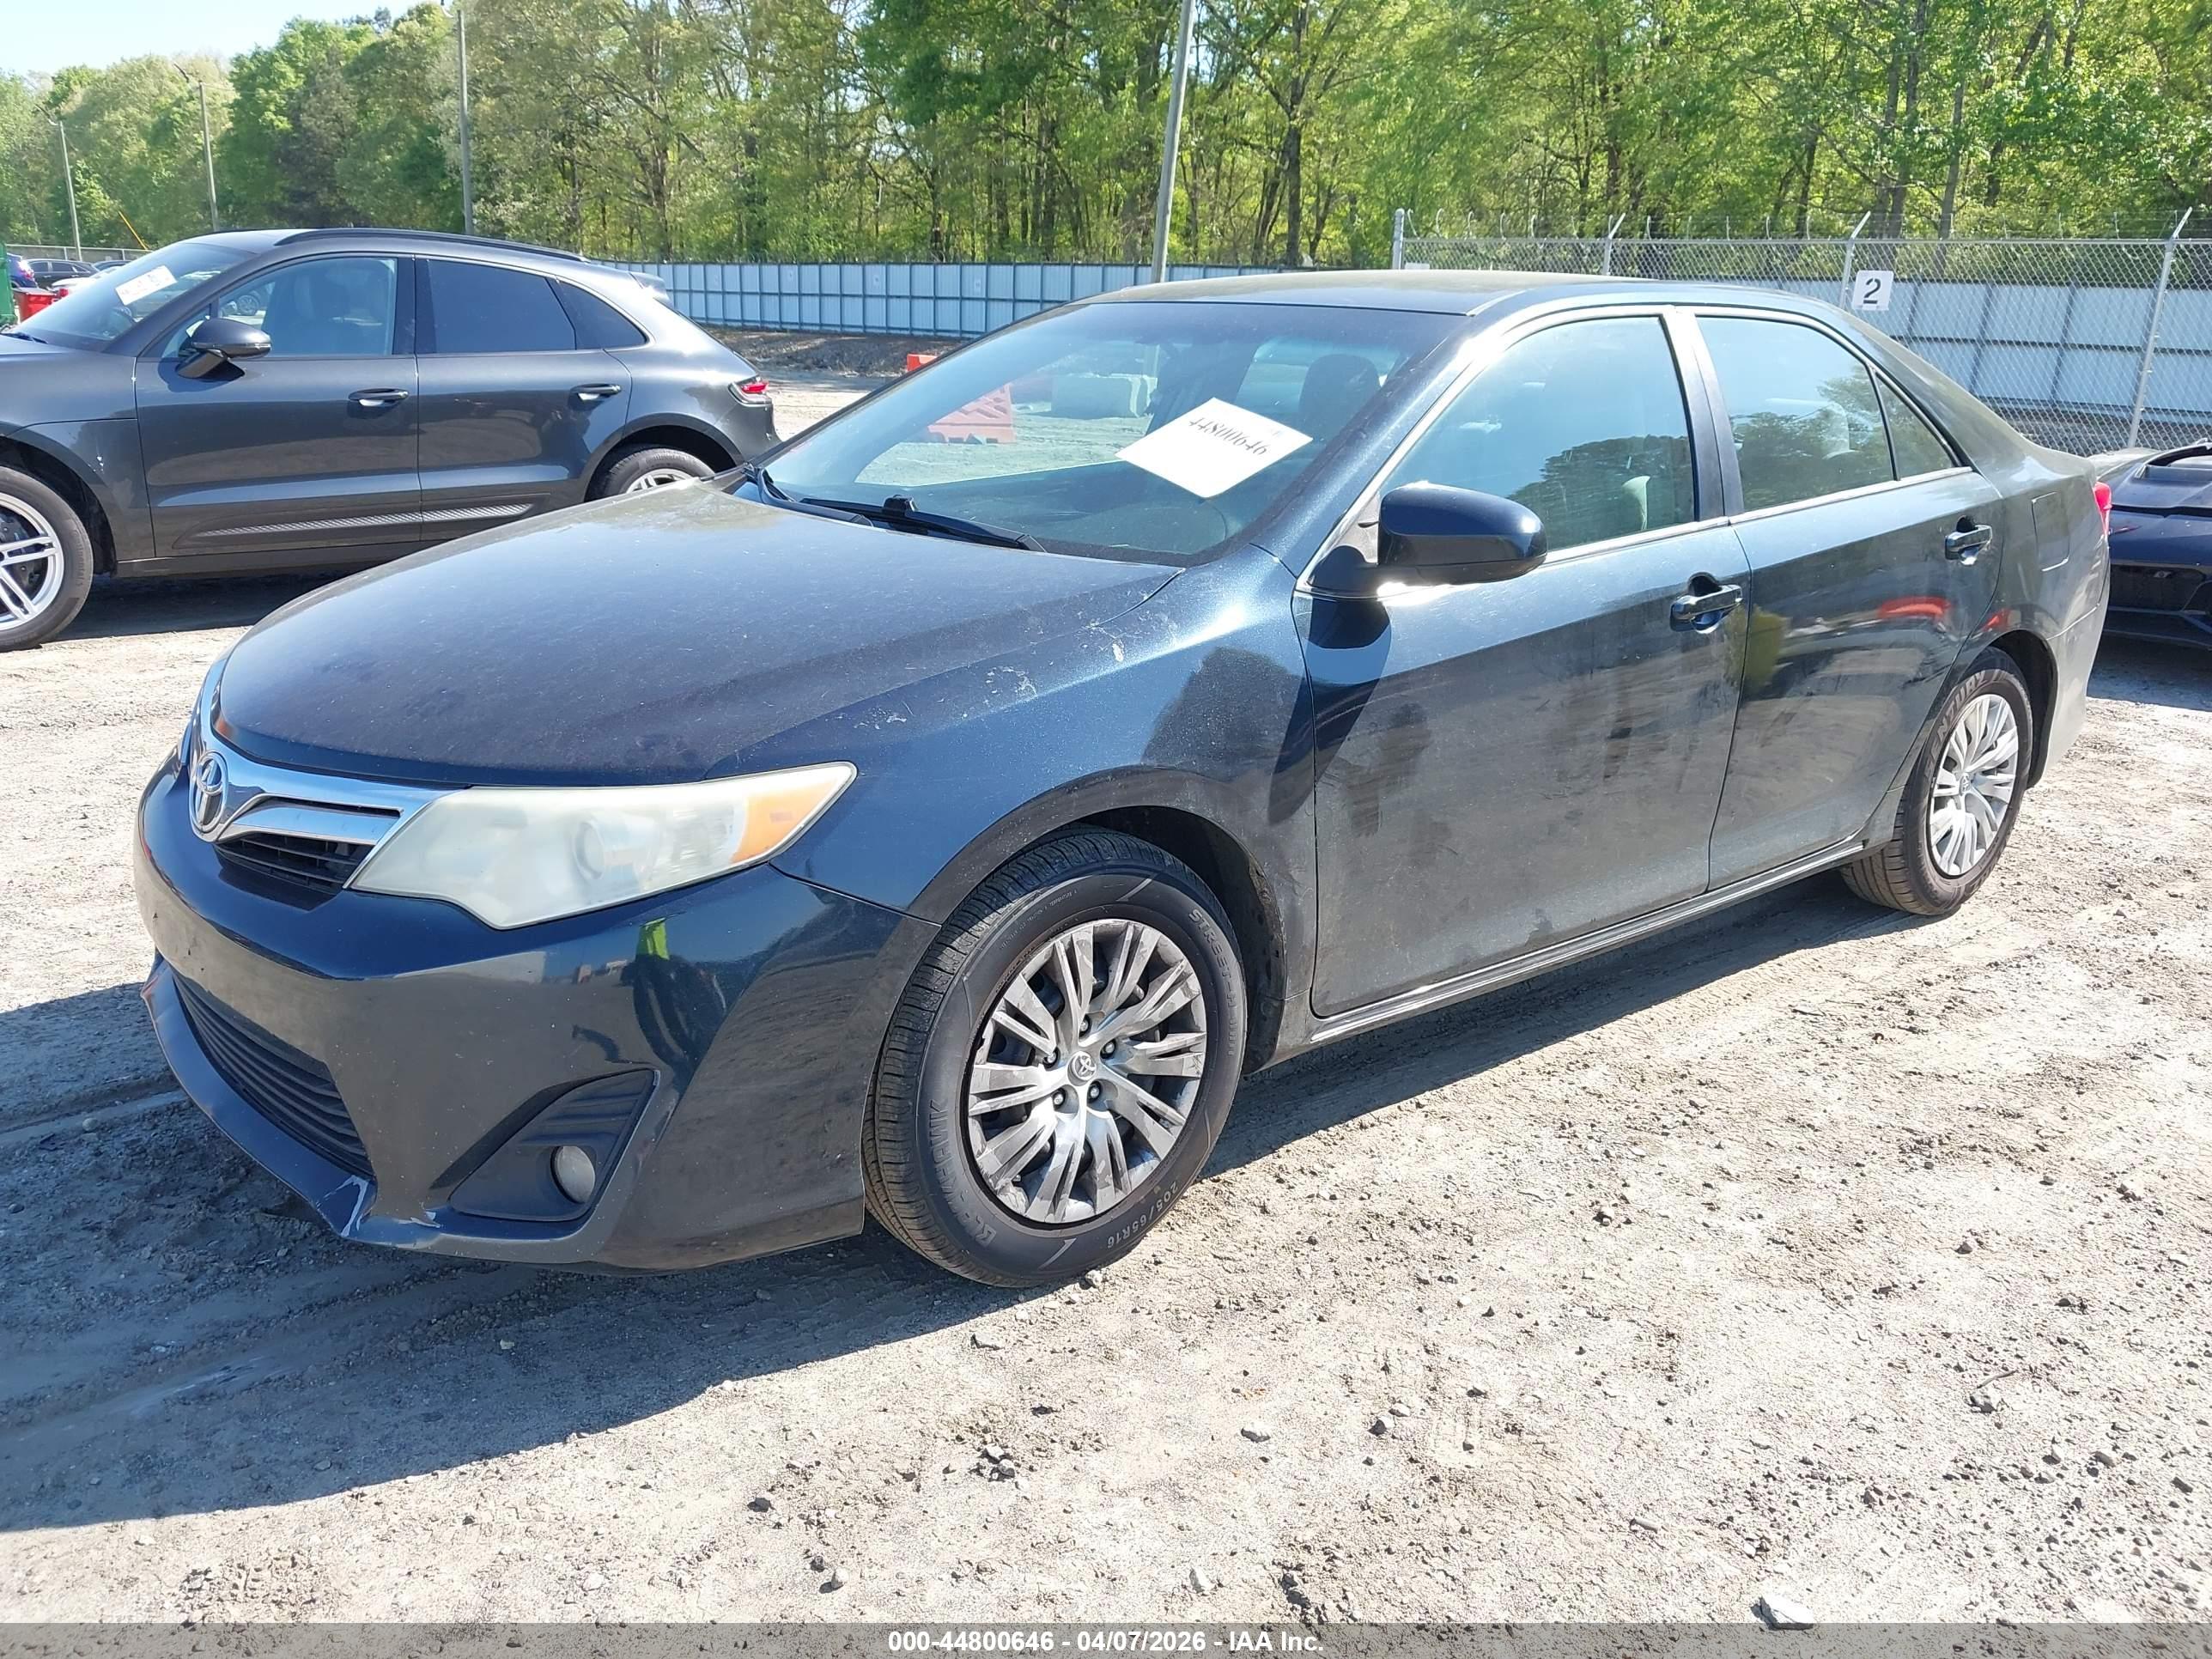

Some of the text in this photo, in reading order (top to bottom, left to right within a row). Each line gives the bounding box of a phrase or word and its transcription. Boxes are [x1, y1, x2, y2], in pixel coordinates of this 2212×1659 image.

[1863, 277, 1881, 305] 2
[1189, 417, 1267, 456] 44800646
[1107, 1181, 1179, 1249] 205/65R16
